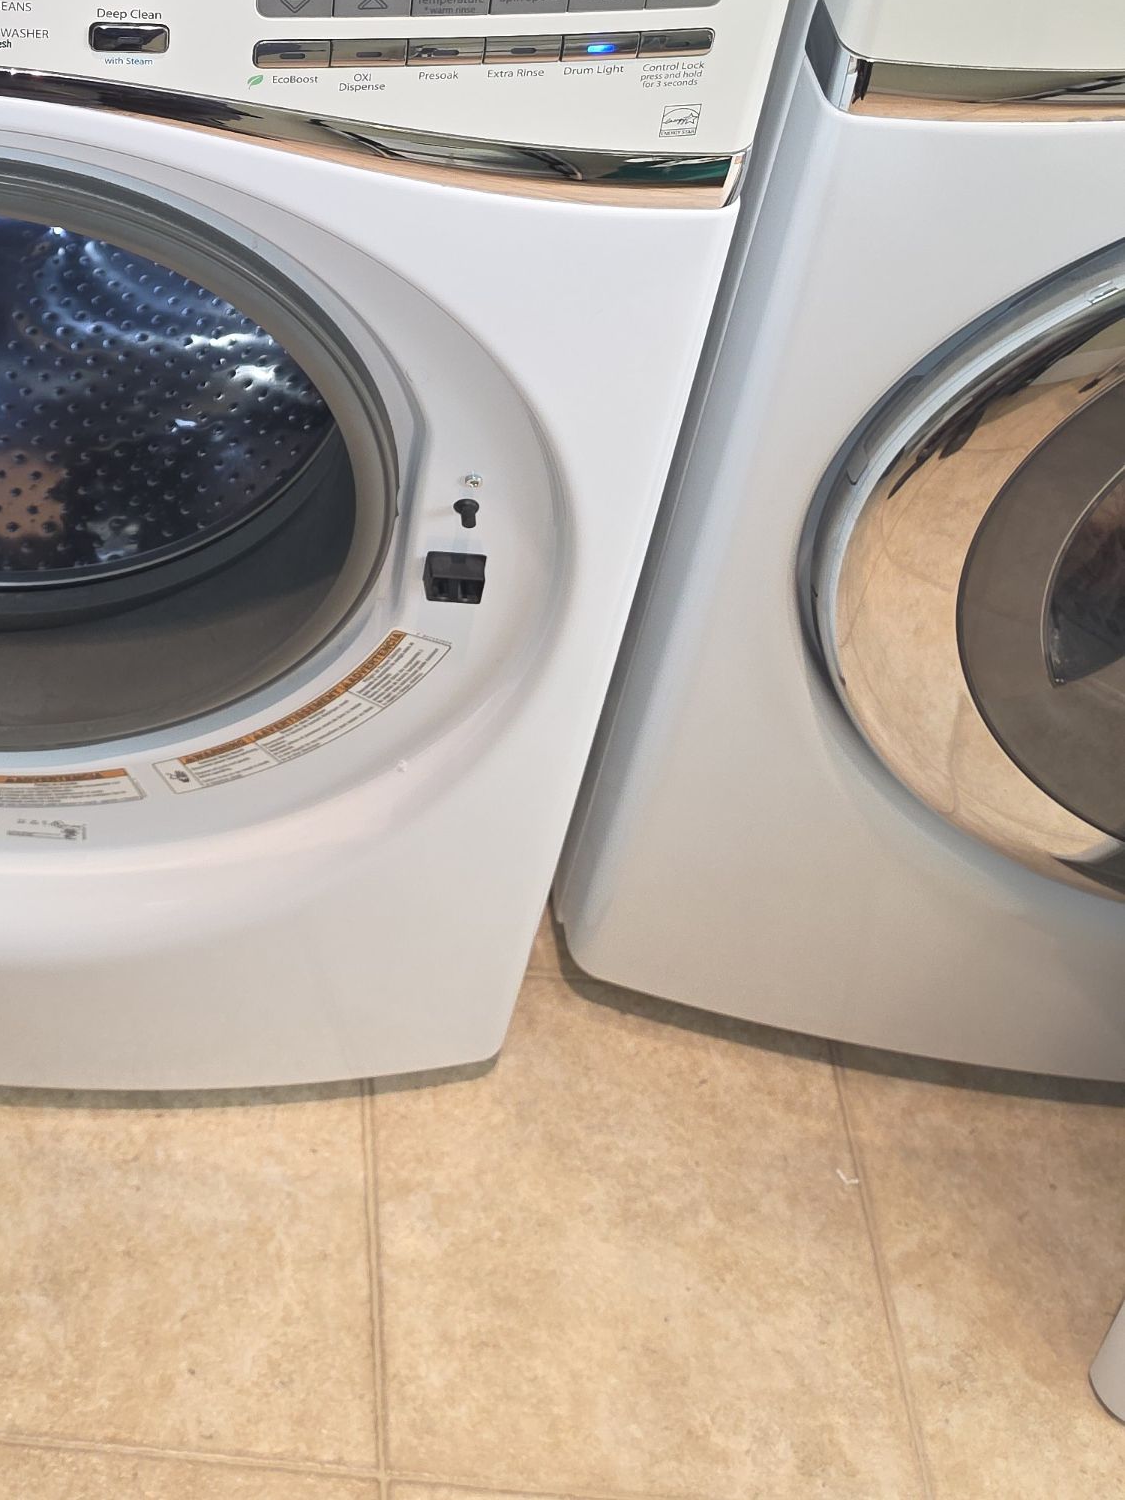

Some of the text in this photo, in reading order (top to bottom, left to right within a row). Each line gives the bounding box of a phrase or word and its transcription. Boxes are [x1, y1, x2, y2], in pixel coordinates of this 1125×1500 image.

[96, 8, 162, 21] Deep Clean
[0, 28, 49, 39] WASHER
[104, 57, 153, 66] with Steam
[642, 60, 704, 72] Control Lock
[487, 68, 545, 78] Extra Rinse
[563, 65, 624, 76] Drum Light
[272, 75, 318, 84] EcoBoost
[353, 73, 372, 82] OXI
[418, 71, 459, 80] Presoak
[640, 70, 703, 82] press and hold
[339, 83, 386, 92] Dispense
[642, 79, 698, 88] for 3 seconds
